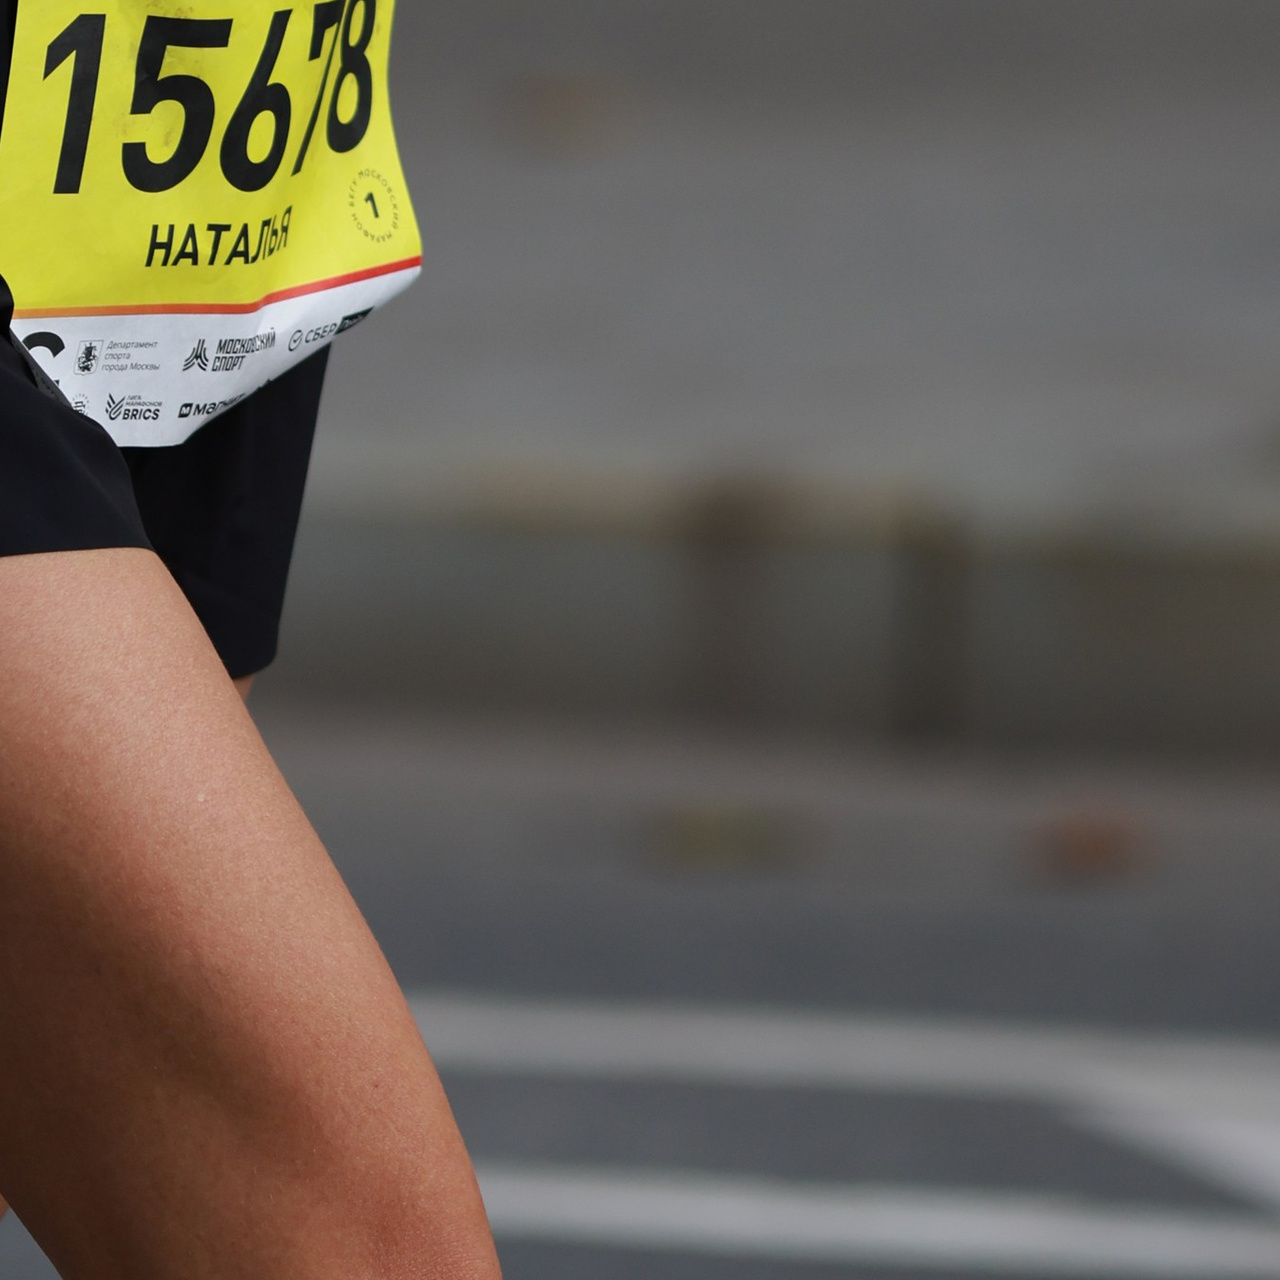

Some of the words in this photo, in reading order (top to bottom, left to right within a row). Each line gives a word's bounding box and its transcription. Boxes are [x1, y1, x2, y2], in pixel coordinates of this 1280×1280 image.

[364, 191, 379, 219] 1
[145, 205, 293, 267] НАТАЛЬЯ
[216, 327, 276, 354] МОСКОВСКИЙ
[304, 322, 338, 344] СБЕР
[106, 340, 158, 350] Департамент
[104, 352, 131, 361] спорта
[211, 355, 246, 372] СПОРТ
[101, 363, 129, 372] города
[129, 362, 161, 371] Москвы
[122, 408, 160, 420] BRICS
